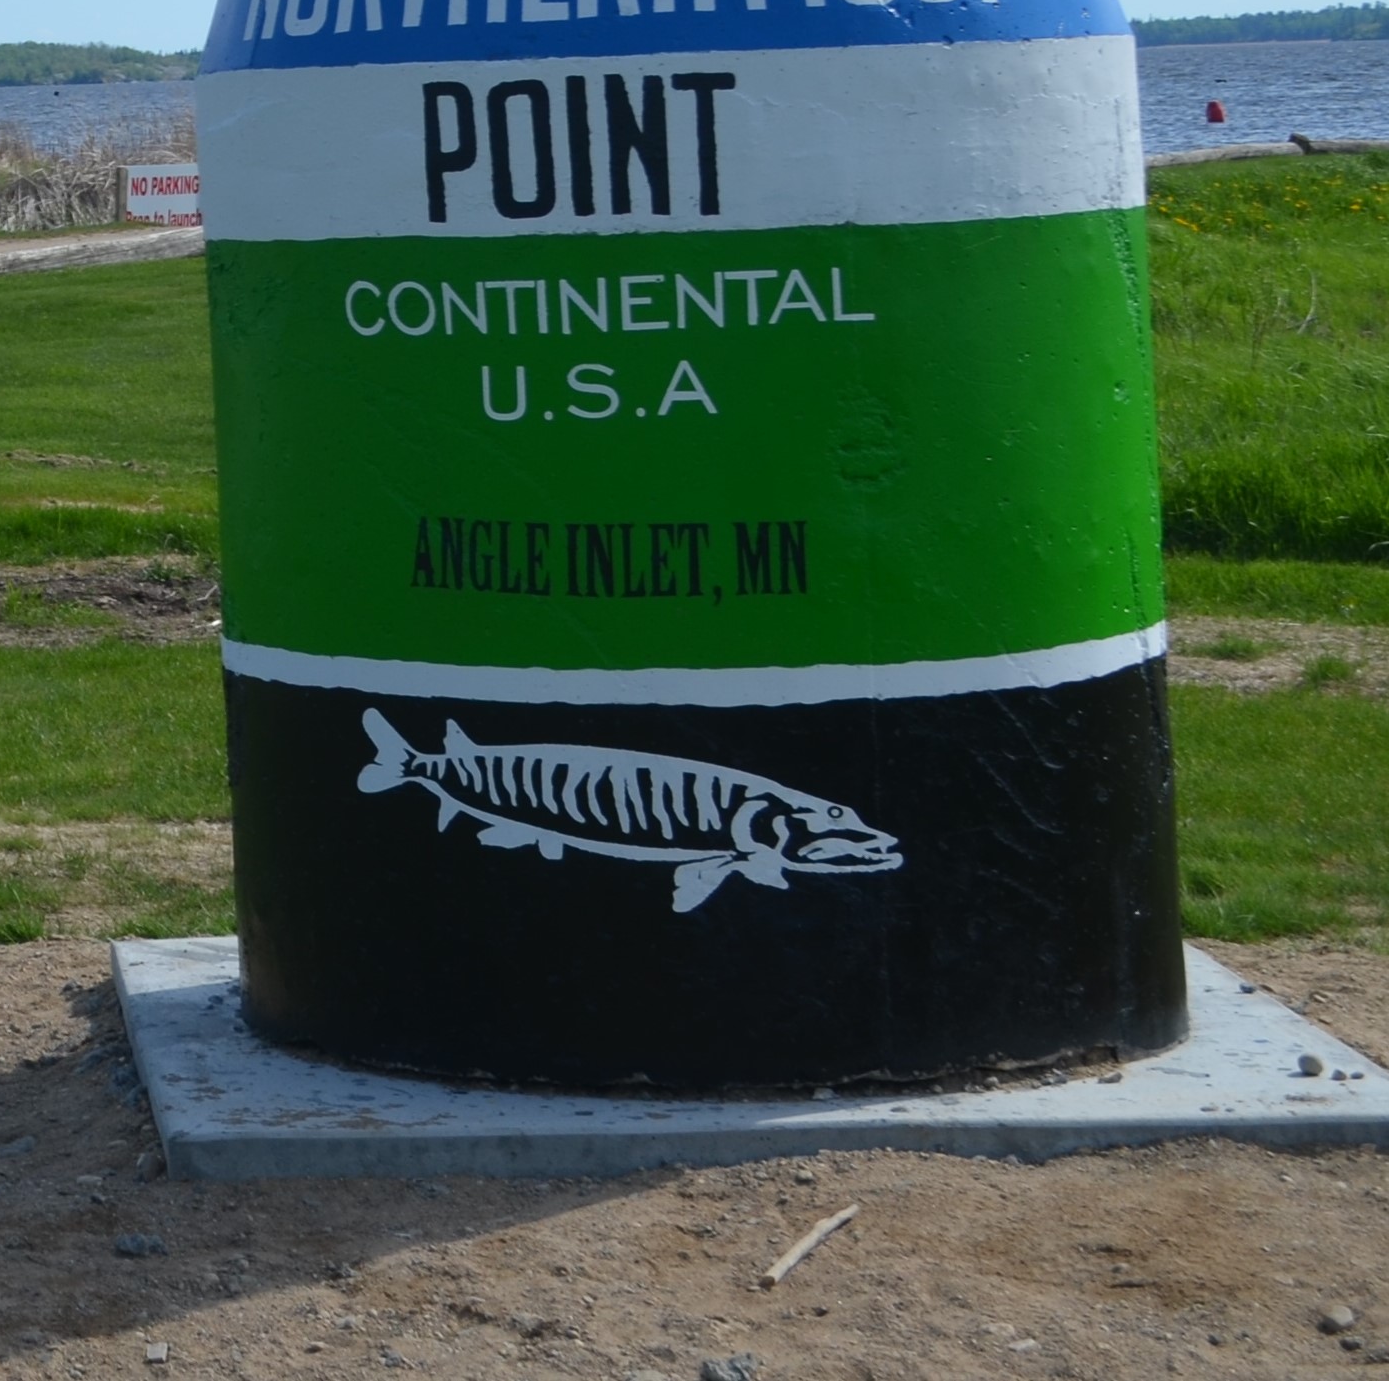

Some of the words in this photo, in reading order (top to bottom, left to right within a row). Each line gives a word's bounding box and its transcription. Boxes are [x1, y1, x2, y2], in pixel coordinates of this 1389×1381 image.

[423, 72, 736, 223] POINT
[130, 177, 148, 196] NO
[151, 175, 200, 196] PARKING
[168, 208, 202, 226] launch
[345, 267, 876, 337] CONTINENTAL
[481, 360, 719, 421] U.S.A
[410, 516, 552, 597] ANGLE
[564, 522, 723, 606] INLET,
[733, 520, 809, 596] MN
